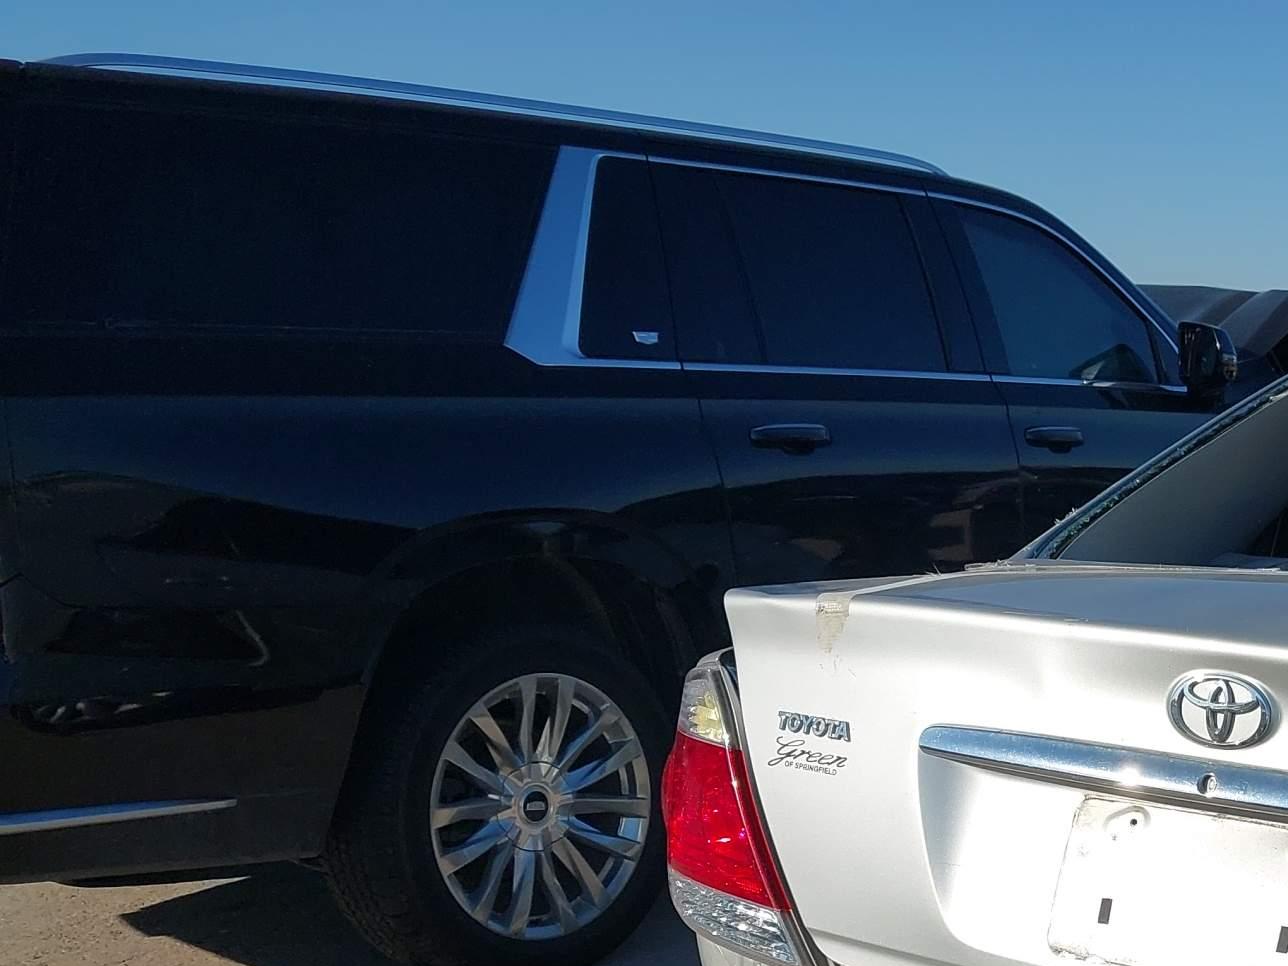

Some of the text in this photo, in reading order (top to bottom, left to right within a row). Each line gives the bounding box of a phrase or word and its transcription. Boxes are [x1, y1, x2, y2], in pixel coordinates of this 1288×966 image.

[778, 710, 851, 742] TOYOTA
[767, 736, 847, 767] Green
[784, 760, 837, 776] OF SPRINGFIELD
